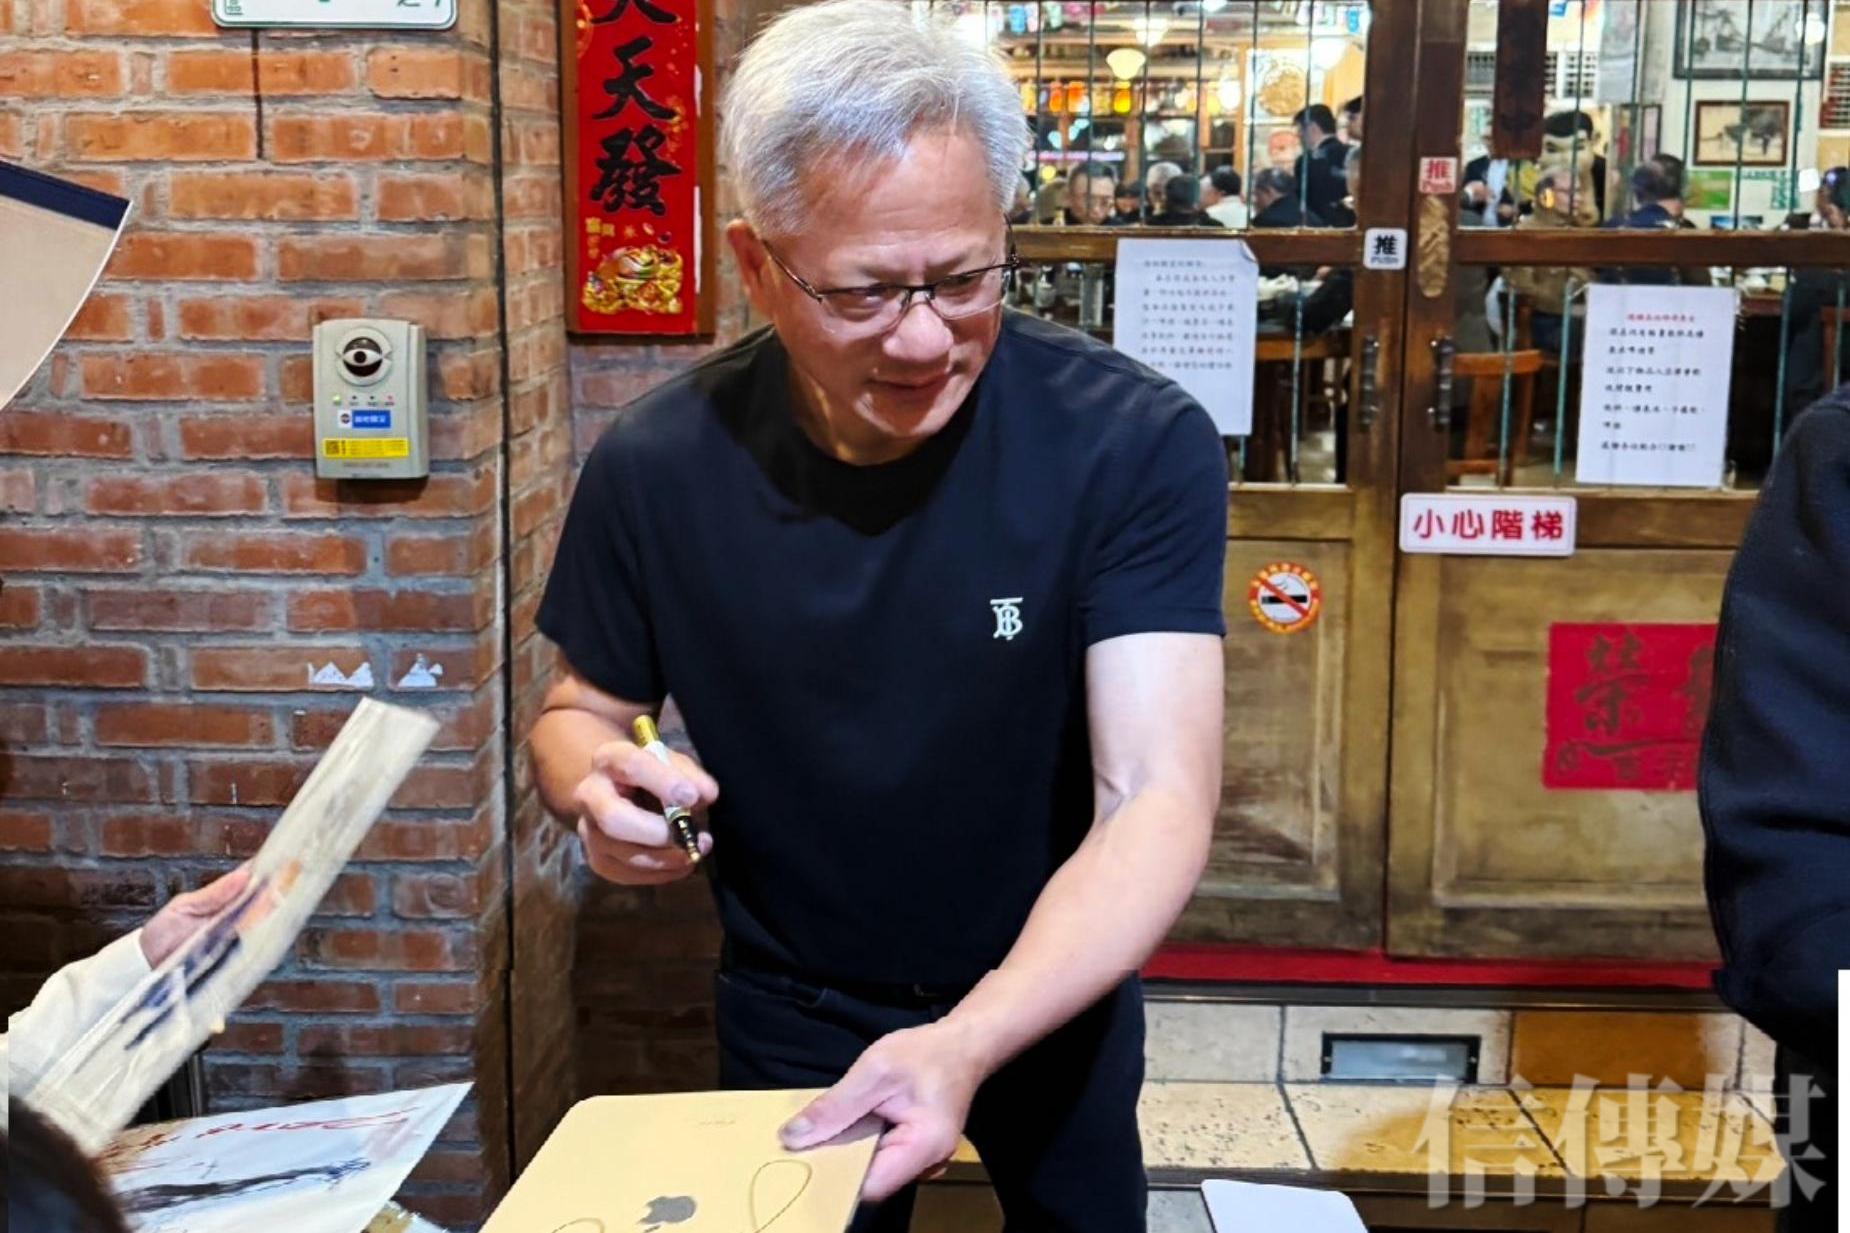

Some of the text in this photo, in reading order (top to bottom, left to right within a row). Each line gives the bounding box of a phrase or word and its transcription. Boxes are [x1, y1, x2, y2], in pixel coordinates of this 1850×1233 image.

[1426, 160, 1451, 179] 推
[1375, 234, 1398, 255] 推
[1413, 508, 1564, 541] 小心階梯
